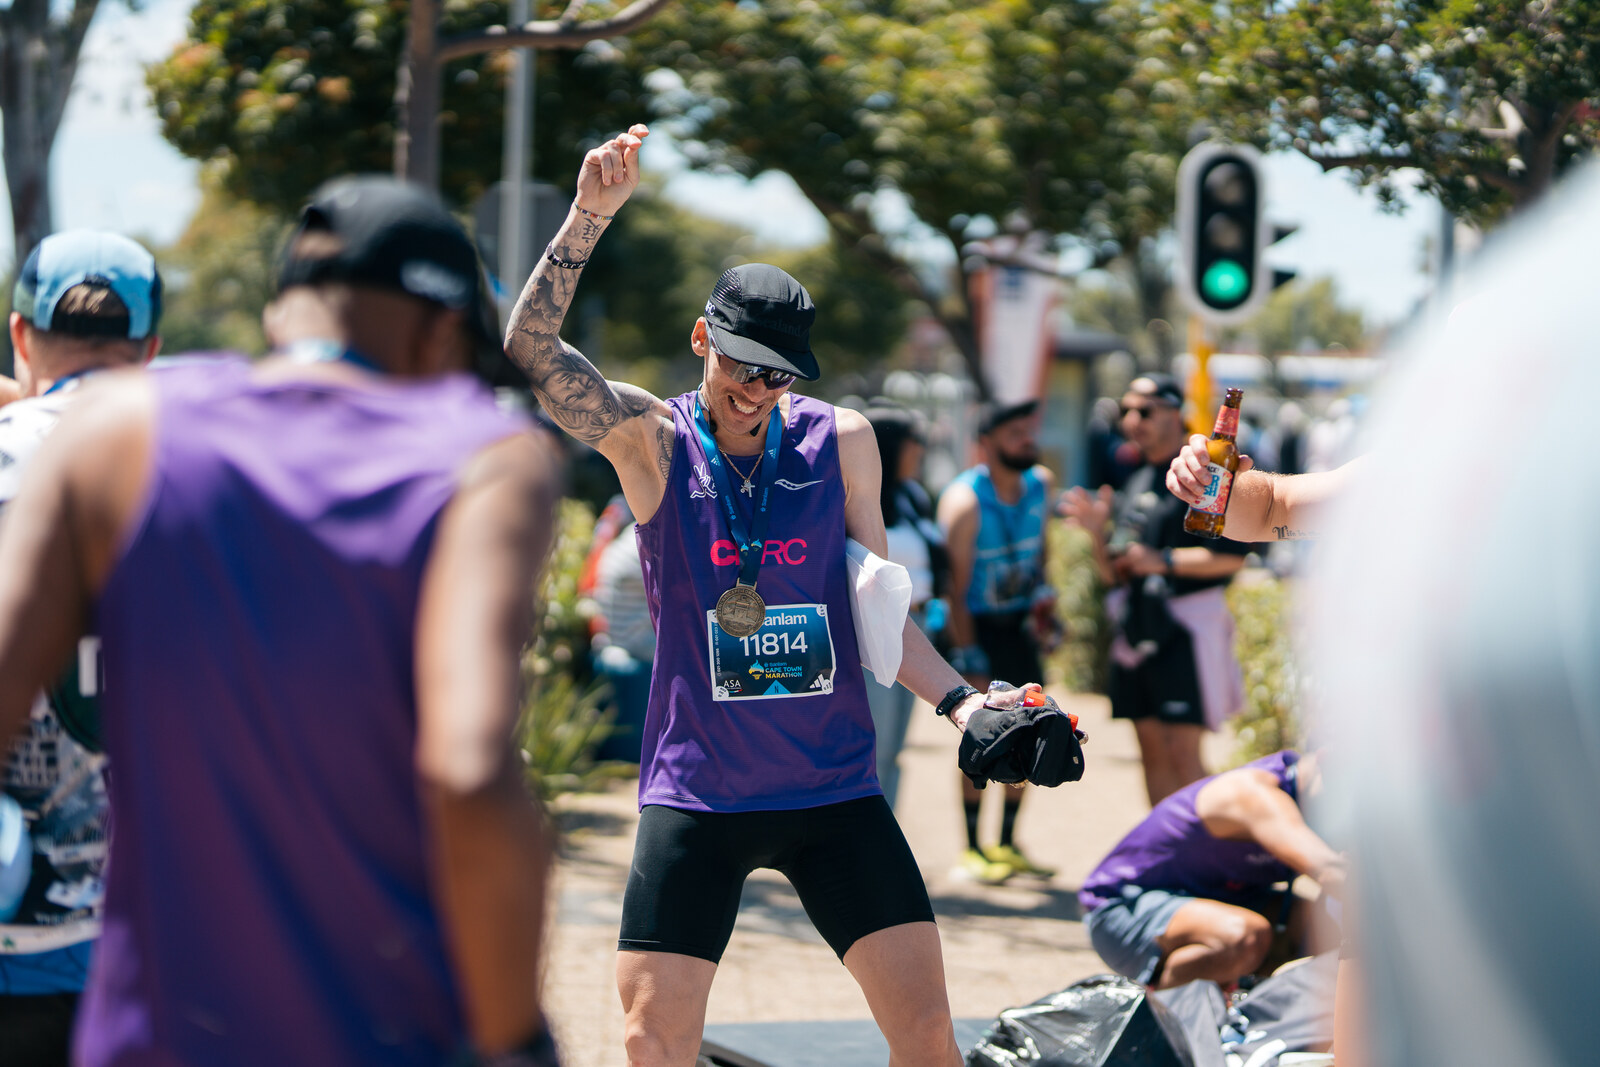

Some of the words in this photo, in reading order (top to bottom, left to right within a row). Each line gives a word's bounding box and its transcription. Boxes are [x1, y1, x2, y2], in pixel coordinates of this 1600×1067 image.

[763, 612, 808, 627] anlam
[739, 631, 808, 657] 11814
[723, 679, 742, 688] ASA
